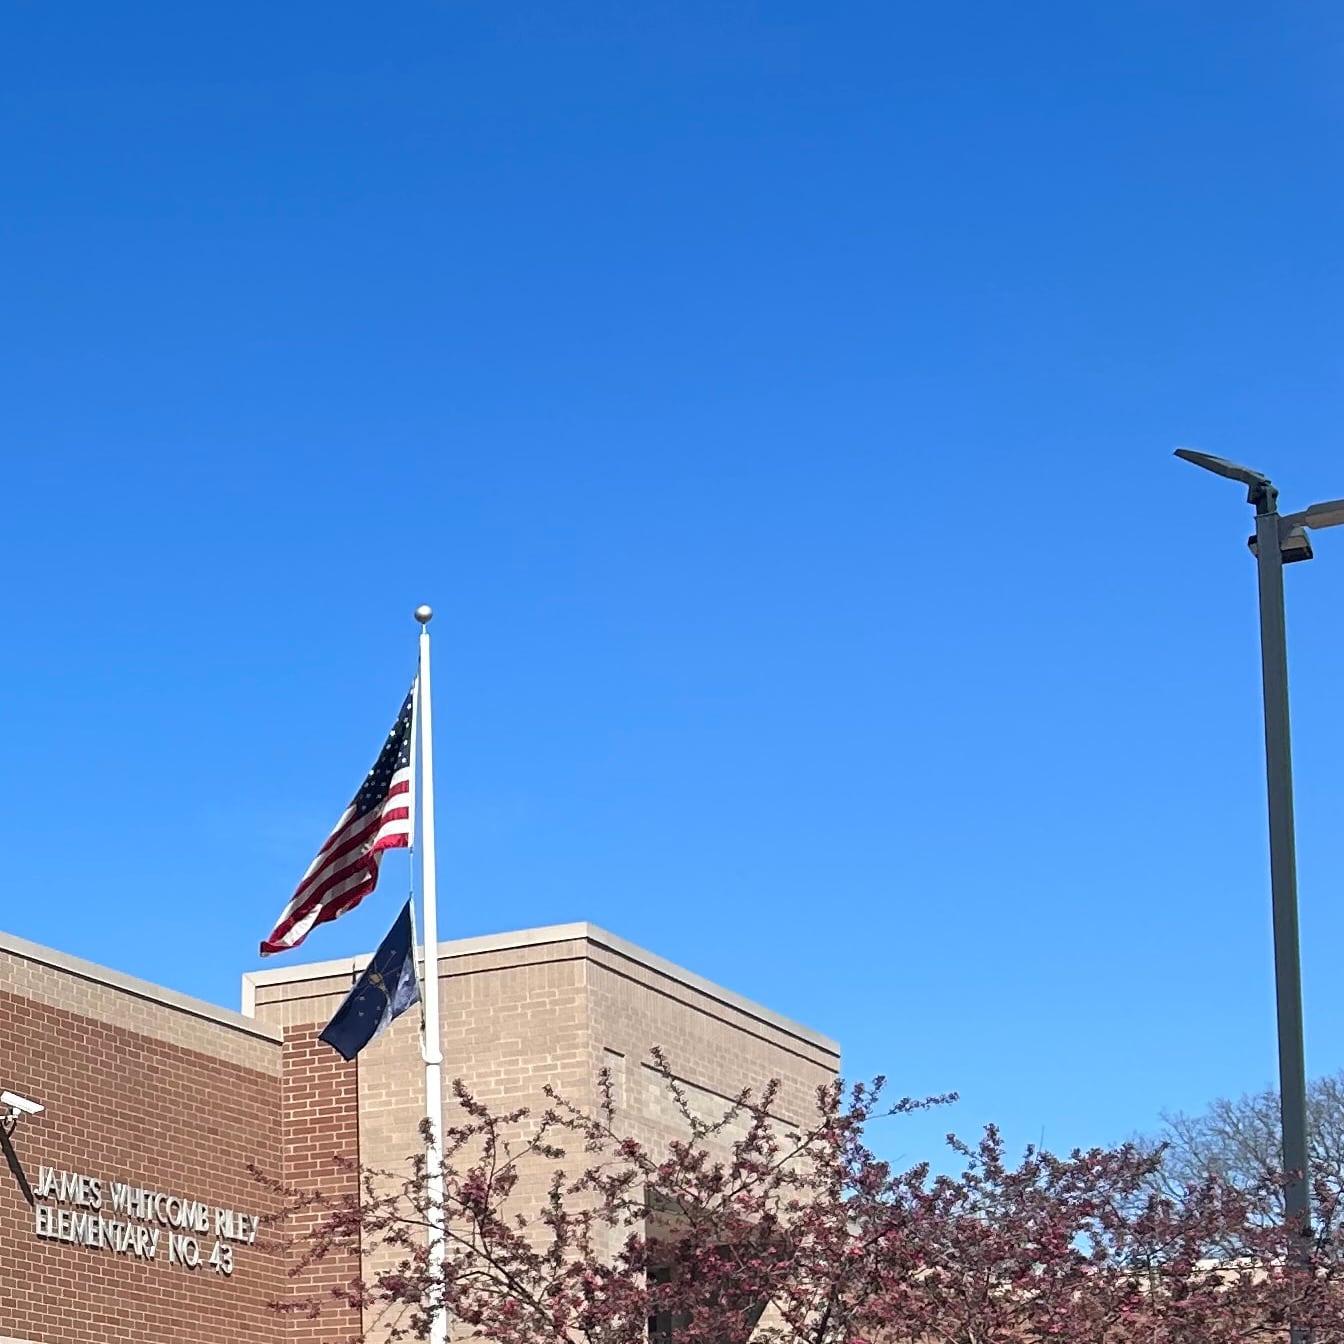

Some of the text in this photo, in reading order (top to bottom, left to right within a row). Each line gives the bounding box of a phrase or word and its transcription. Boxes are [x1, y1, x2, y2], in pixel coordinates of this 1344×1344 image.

[34, 1166, 260, 1243] JAMES WHITCOMB RILEY
[35, 1204, 233, 1274] ELEMENTARY NO. 43
